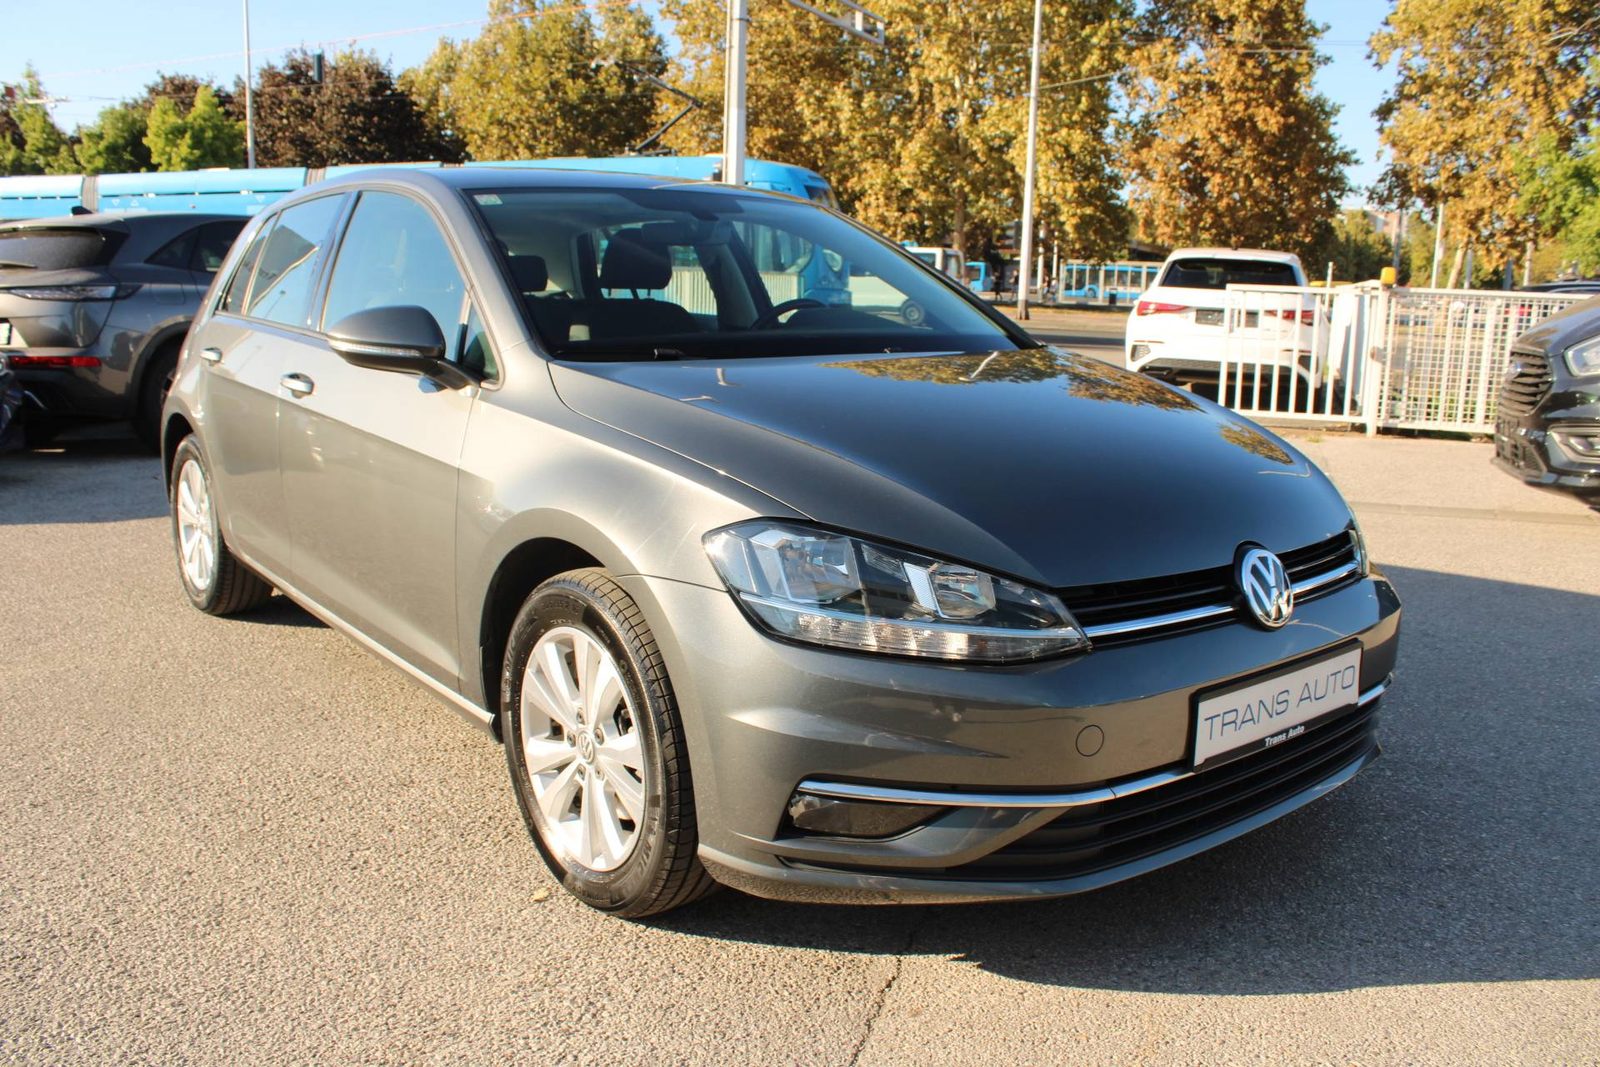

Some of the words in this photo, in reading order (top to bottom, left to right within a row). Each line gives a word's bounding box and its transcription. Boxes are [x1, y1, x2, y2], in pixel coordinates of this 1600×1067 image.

[1204, 689, 1289, 740] TRANS
[1296, 665, 1356, 708] AUTO
[1265, 731, 1287, 746] Trans
[1287, 725, 1305, 739] Auto
